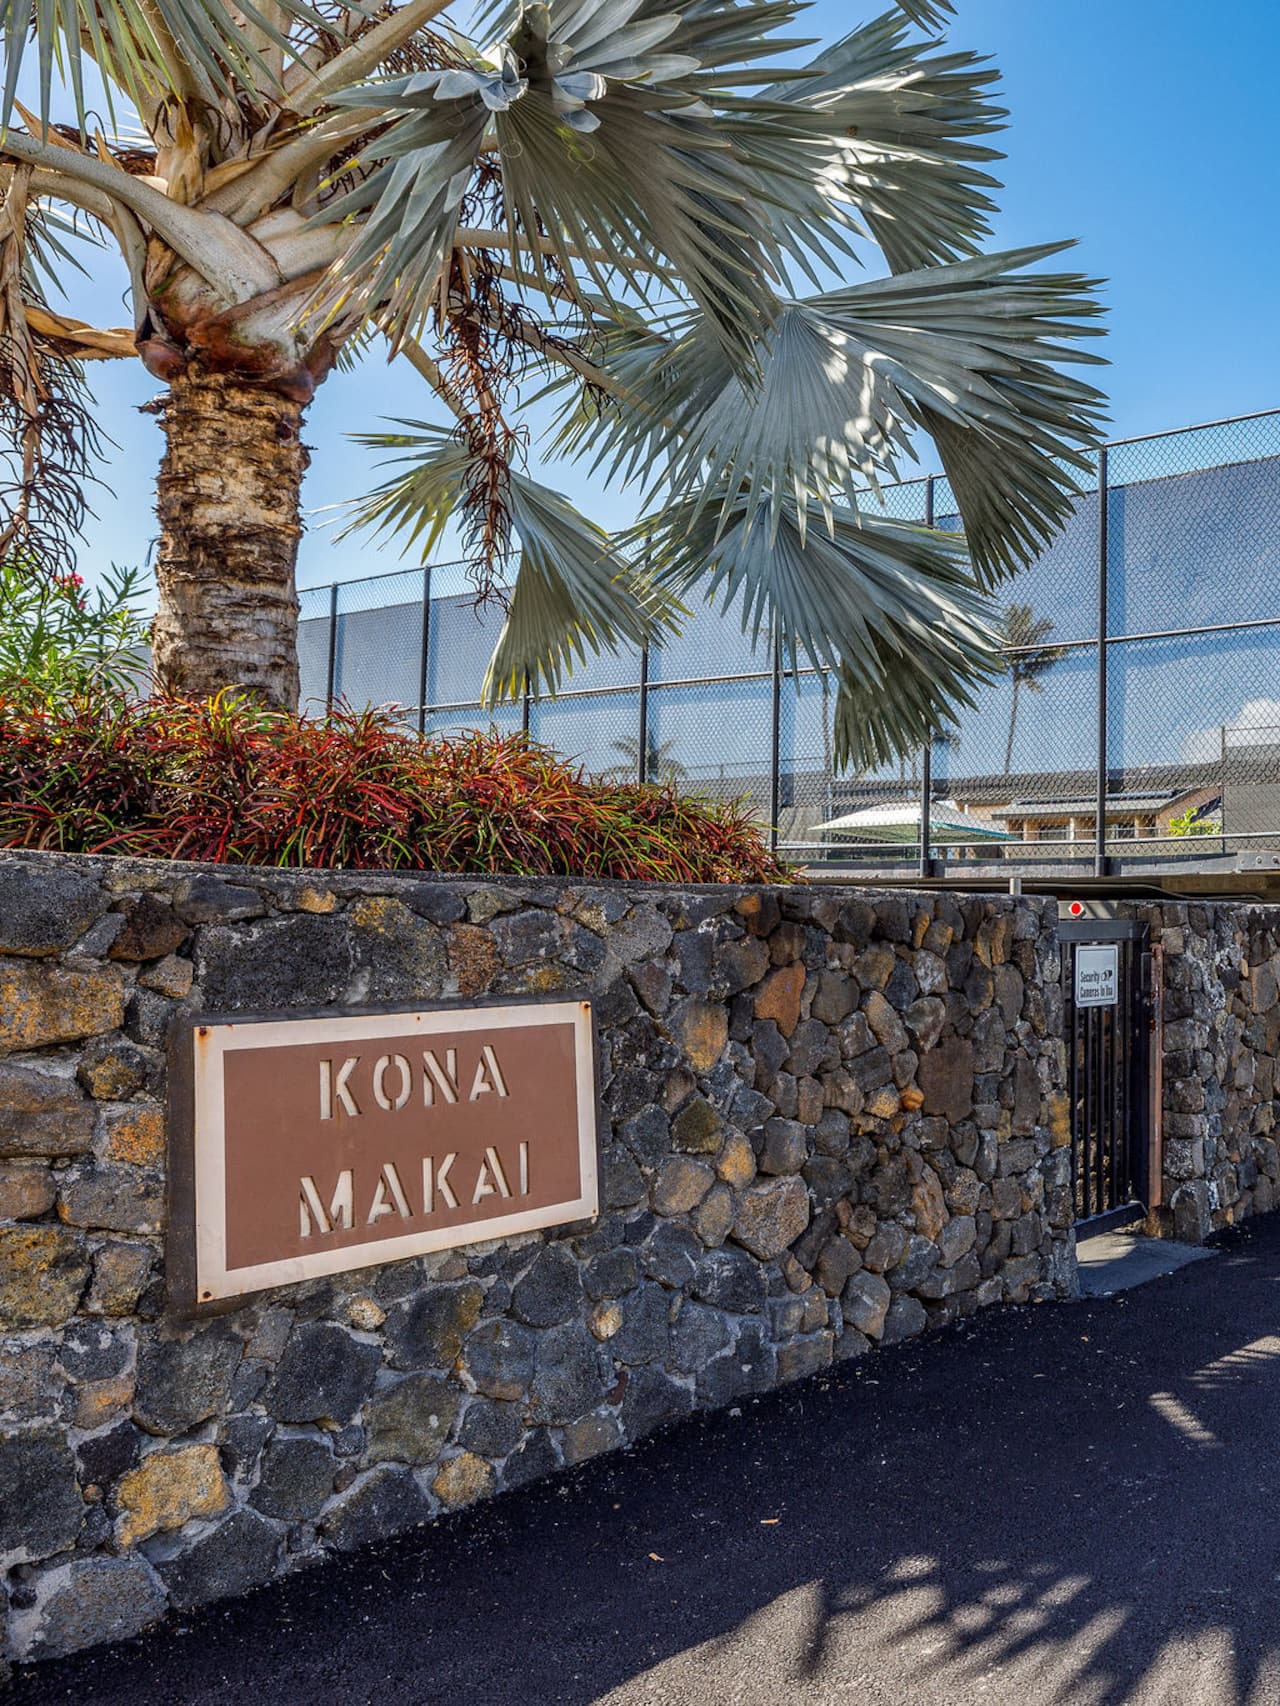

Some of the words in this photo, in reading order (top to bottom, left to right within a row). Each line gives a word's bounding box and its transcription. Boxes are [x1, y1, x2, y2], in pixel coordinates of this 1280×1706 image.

[1080, 969, 1100, 984] Security
[1080, 986, 1100, 998] Cameras
[318, 1044, 510, 1120] KONA
[299, 1140, 529, 1239] MAKAI
